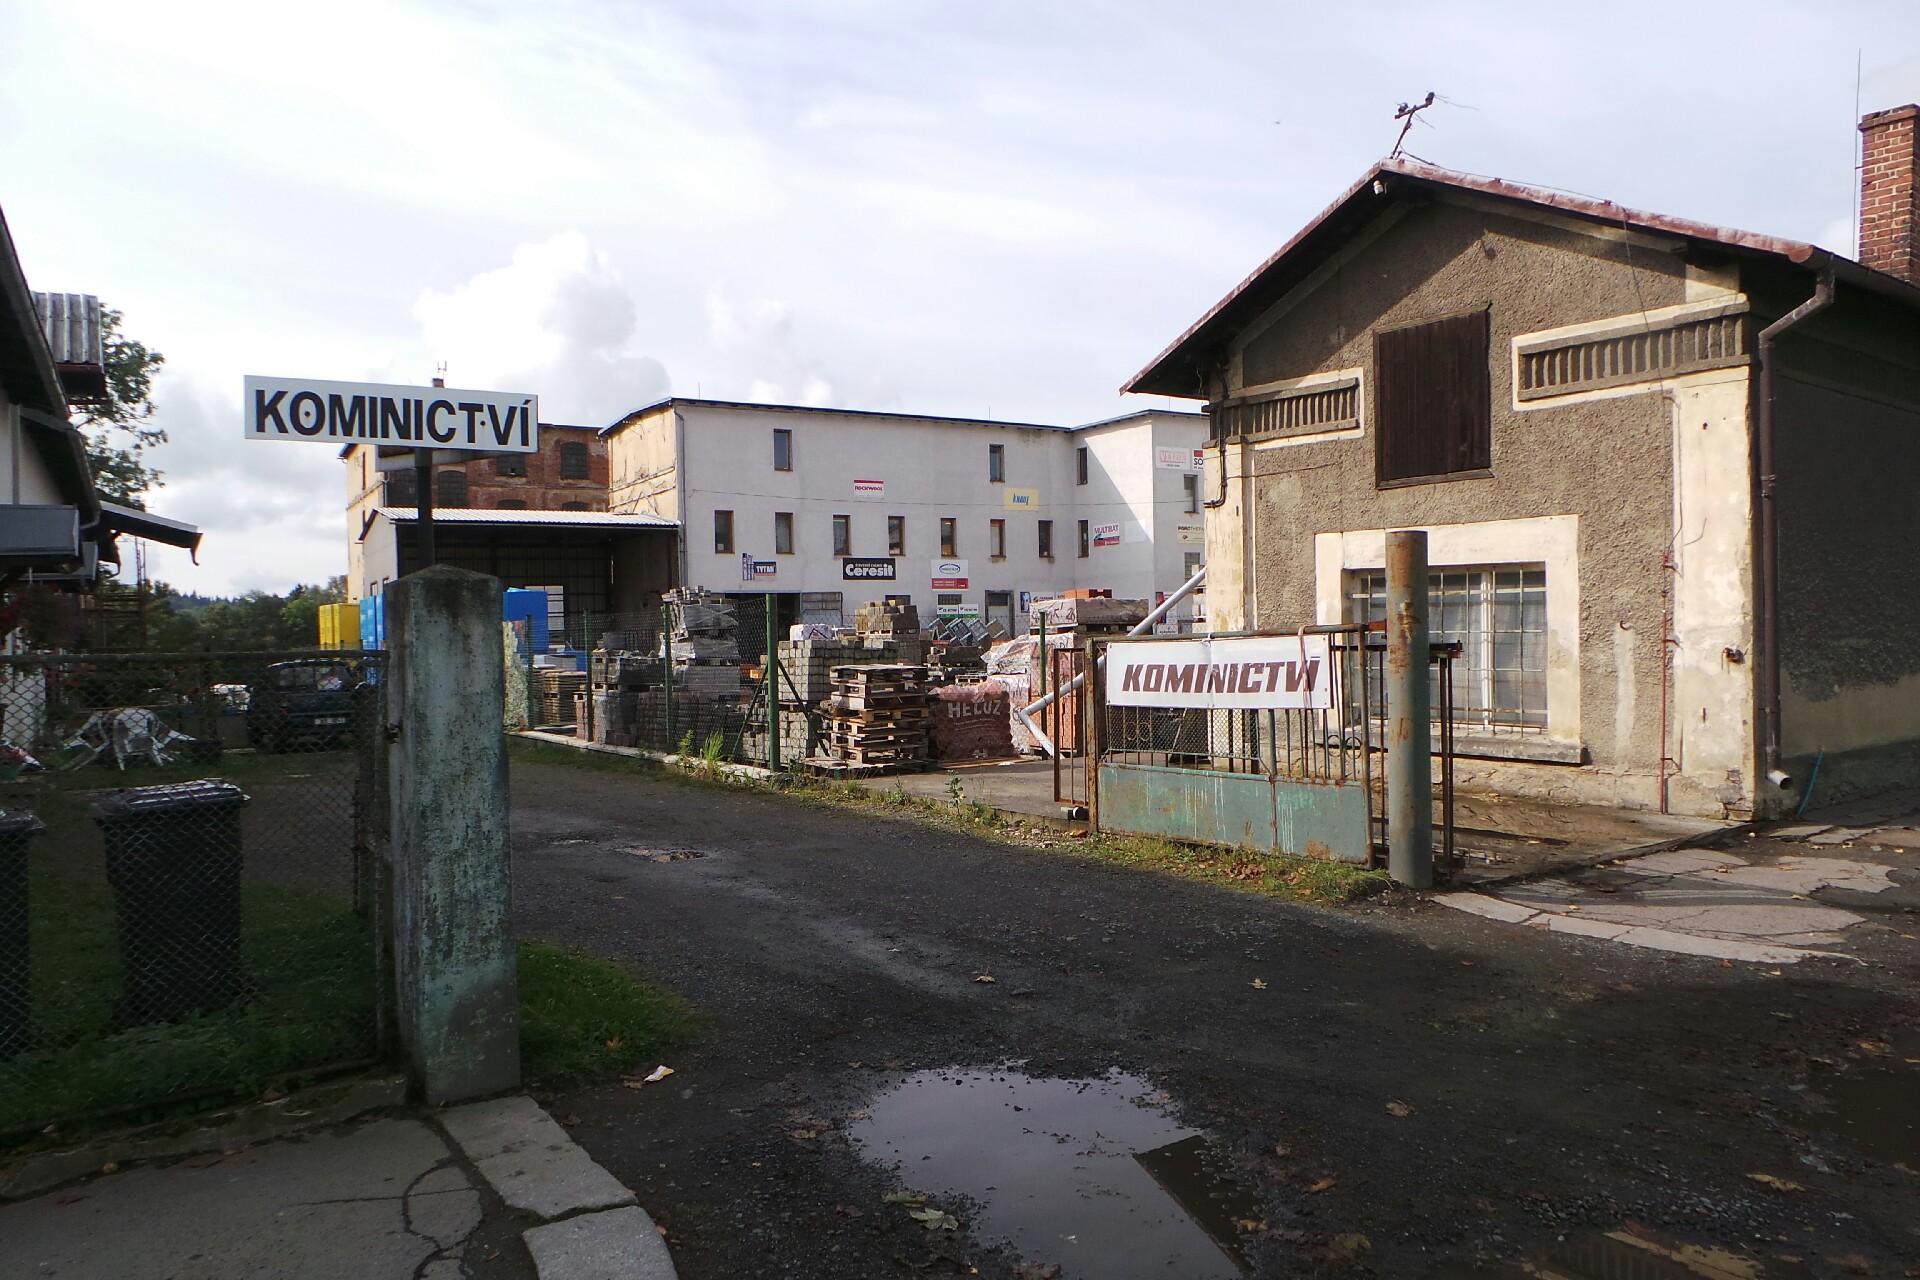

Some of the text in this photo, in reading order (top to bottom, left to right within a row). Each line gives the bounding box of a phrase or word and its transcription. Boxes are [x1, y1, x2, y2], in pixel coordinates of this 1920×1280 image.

[255, 389, 532, 447] KOMINICTVÍ
[845, 563, 894, 577] Ceresit
[1122, 655, 1321, 694] KOMINICTVÍ
[947, 700, 1002, 718] HELUZ
